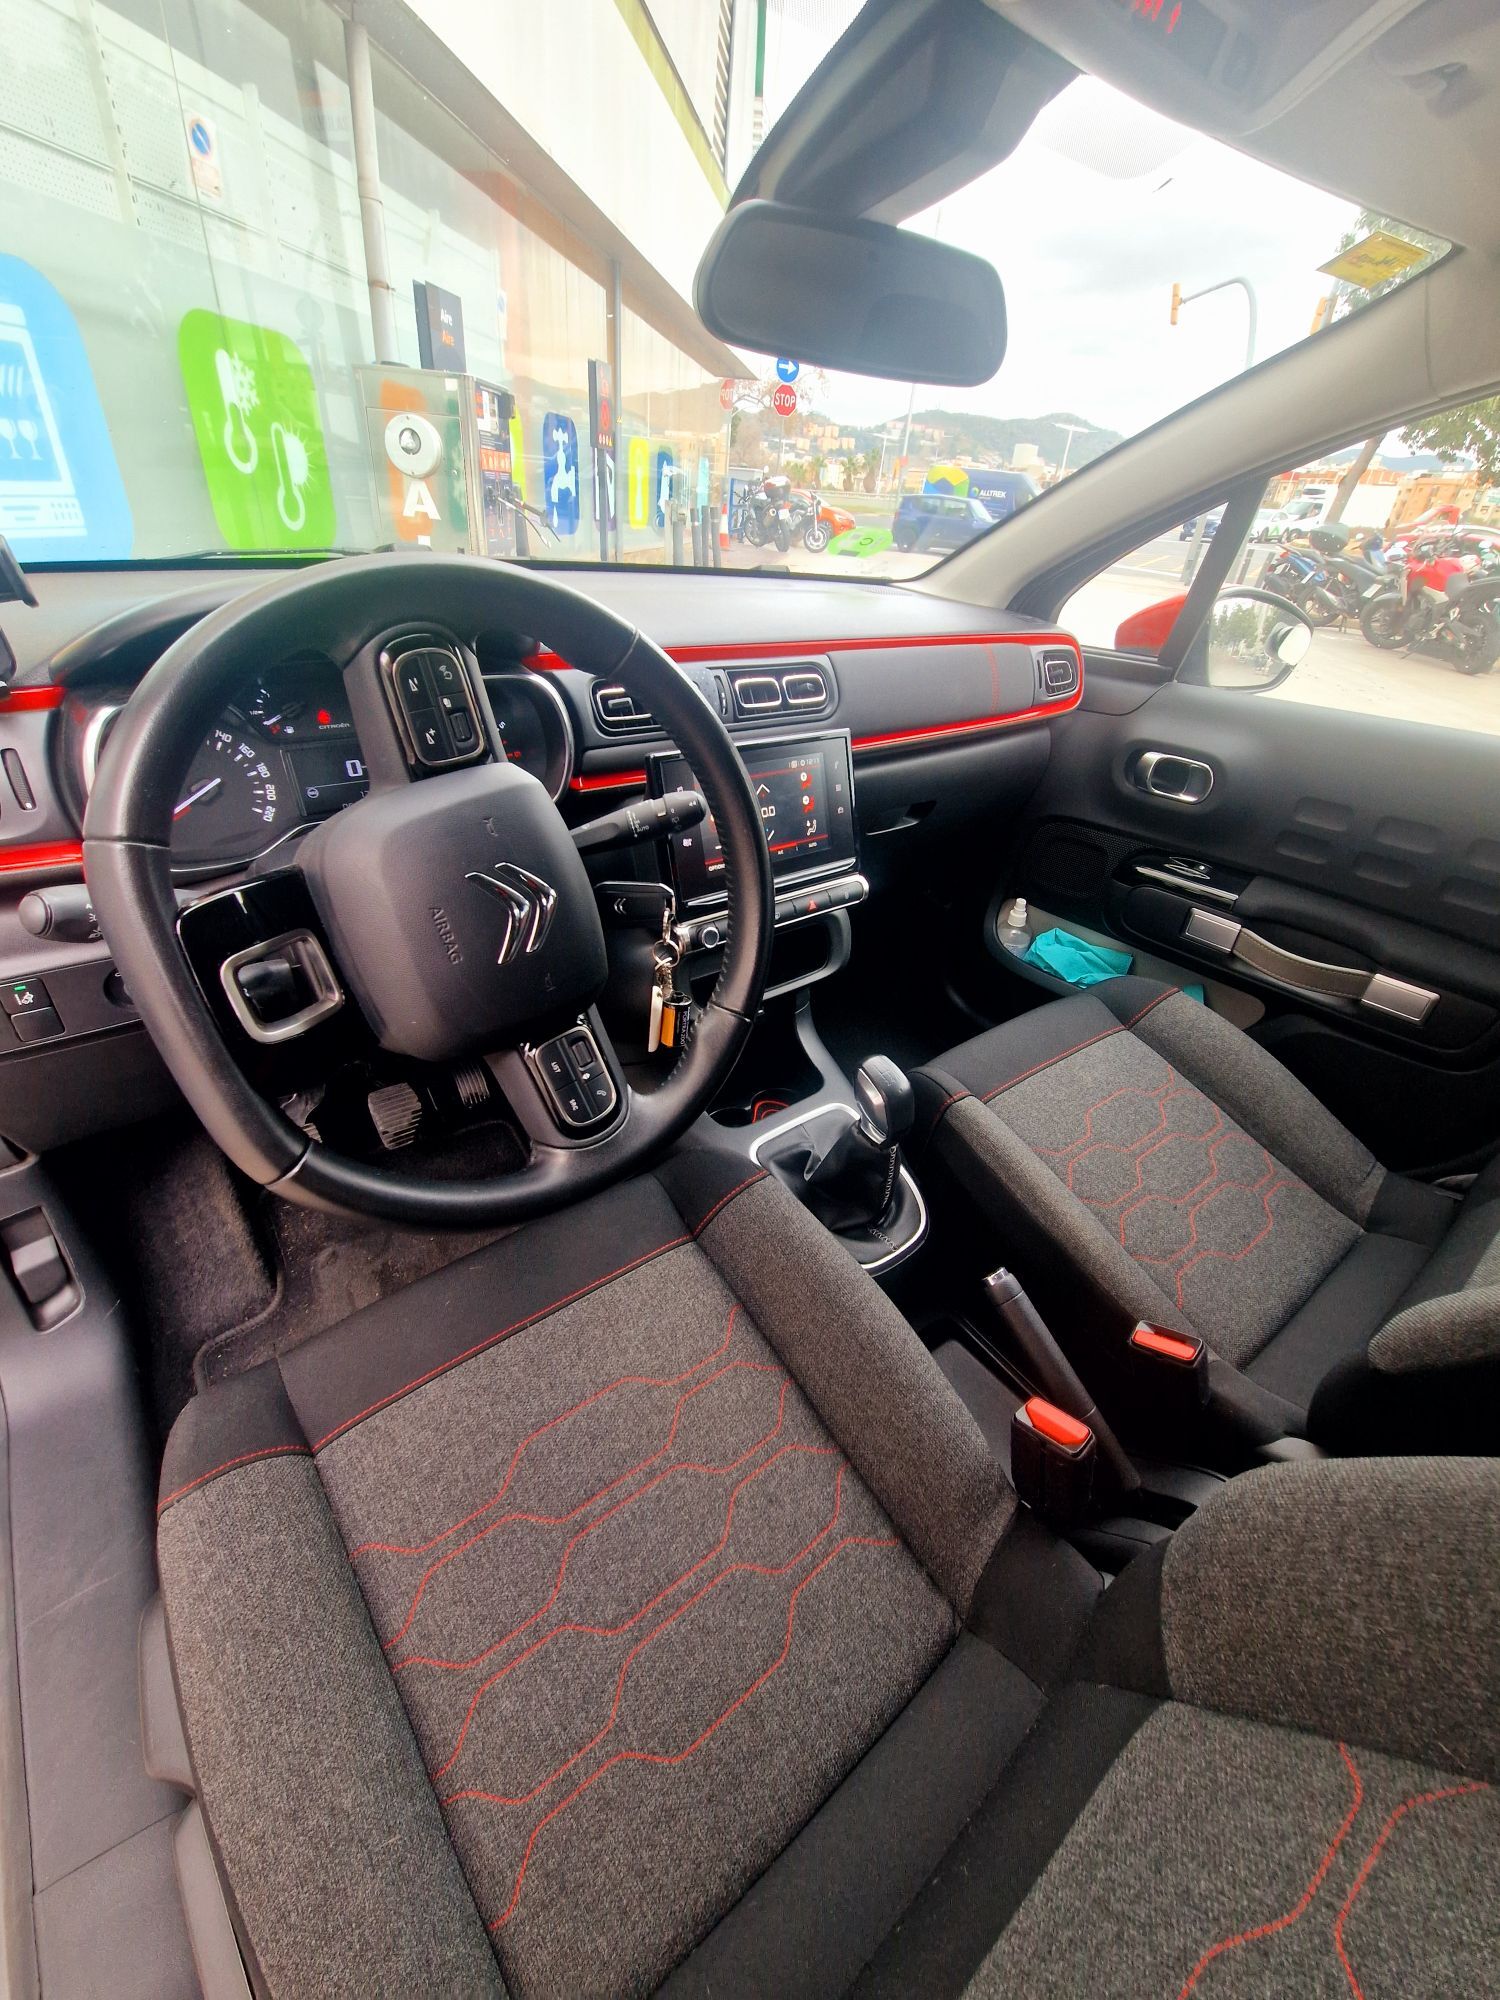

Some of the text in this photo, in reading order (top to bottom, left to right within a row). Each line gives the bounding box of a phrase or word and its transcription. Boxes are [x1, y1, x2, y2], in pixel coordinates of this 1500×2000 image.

[775, 393, 795, 407] STOP
[979, 489, 1006, 498] ALLTREK
[215, 730, 232, 743] 140
[239, 743, 255, 758] 160
[256, 763, 271, 778] 180
[265, 784, 276, 801] 200
[263, 805, 276, 822] 220
[430, 905, 463, 965] AIRBAG
